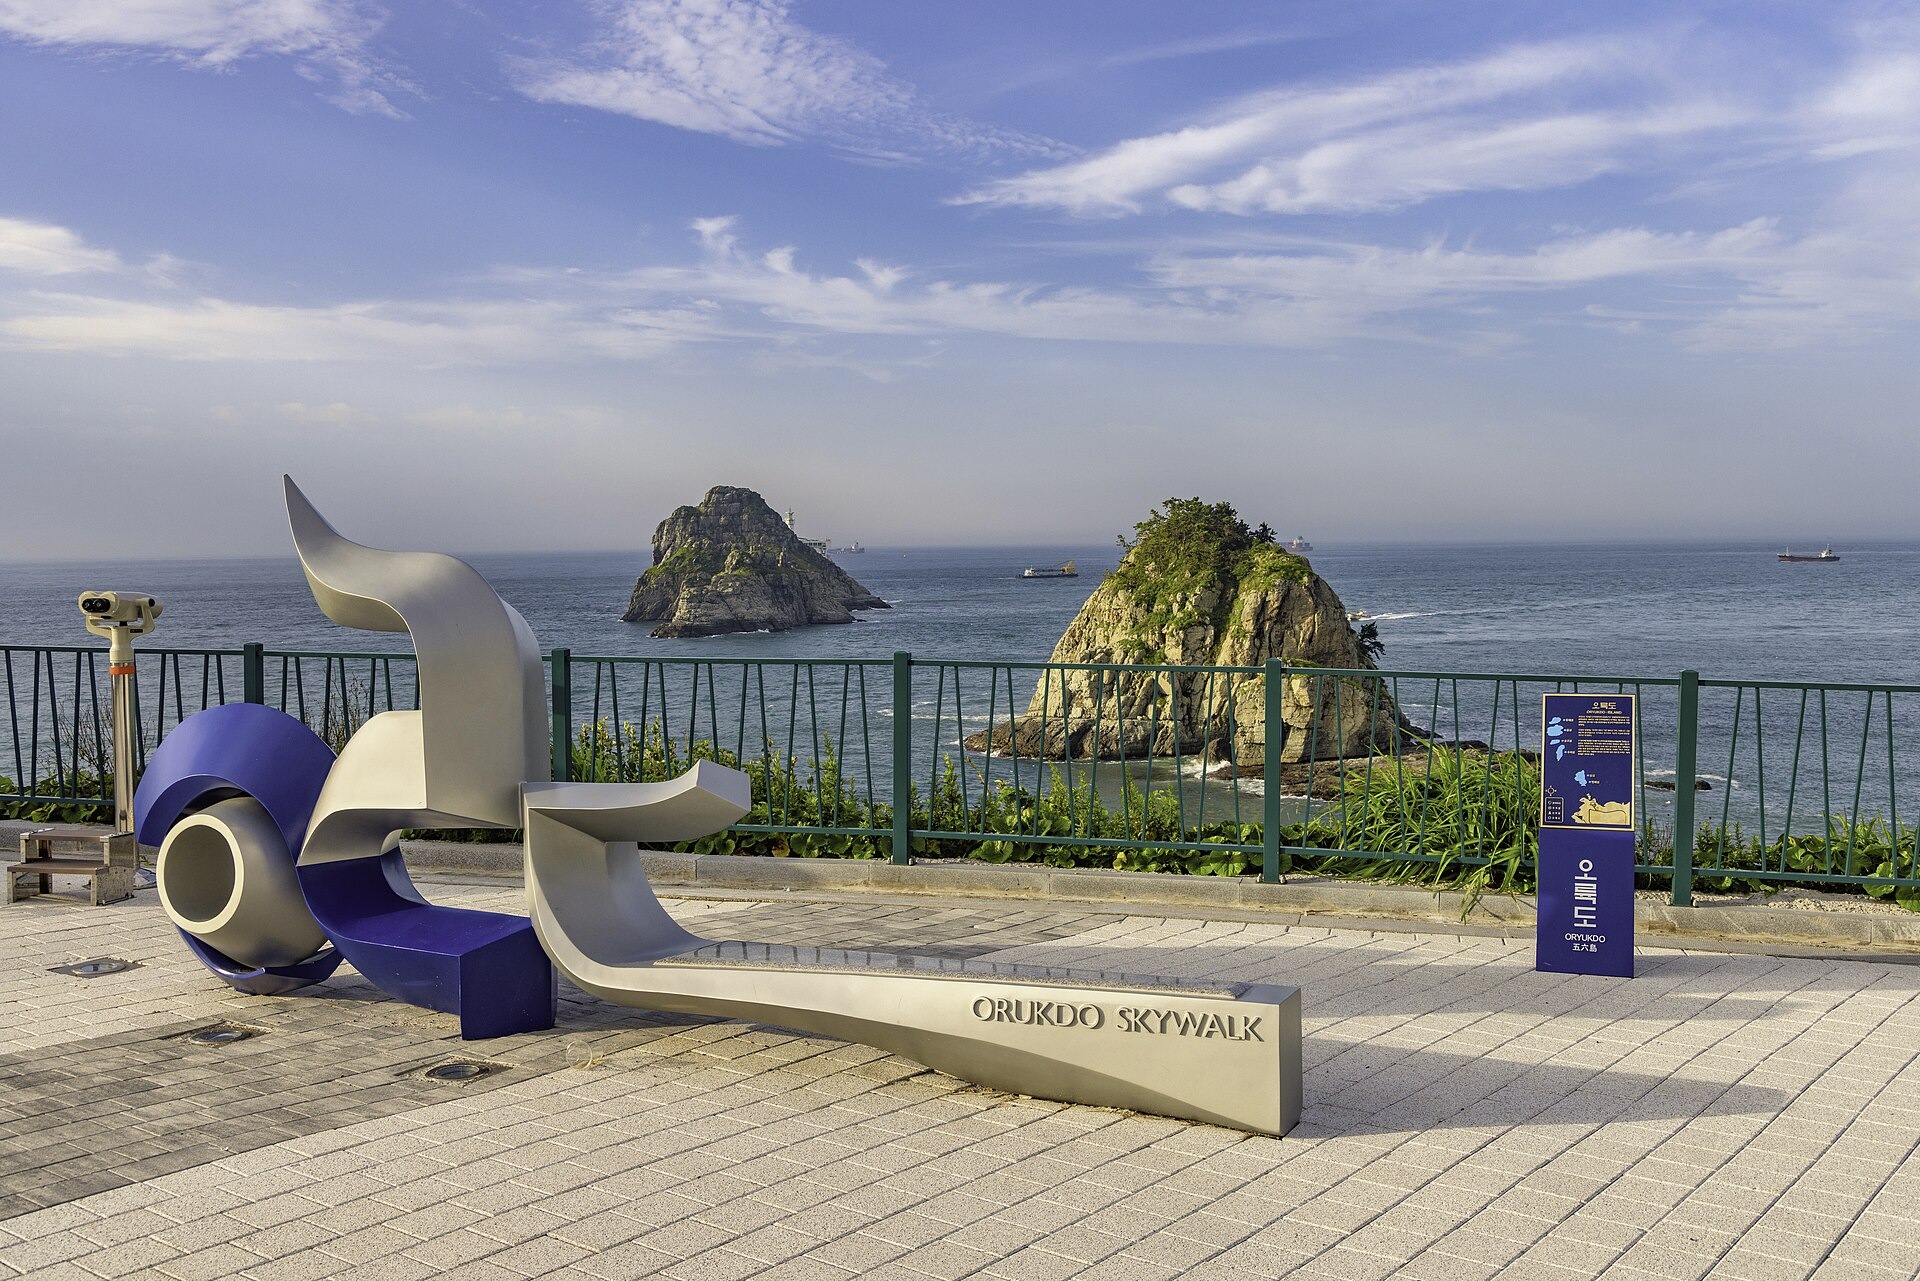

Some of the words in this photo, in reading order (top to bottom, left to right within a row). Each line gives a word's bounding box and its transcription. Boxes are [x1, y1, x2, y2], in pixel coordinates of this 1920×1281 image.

[1574, 859, 1597, 927] 오륙도
[1565, 933, 1606, 943] ORYUKDO
[1572, 943, 1597, 952] 五六島
[972, 995, 1105, 1029] ORUKDO
[1116, 1006, 1264, 1042] SKYWALK
